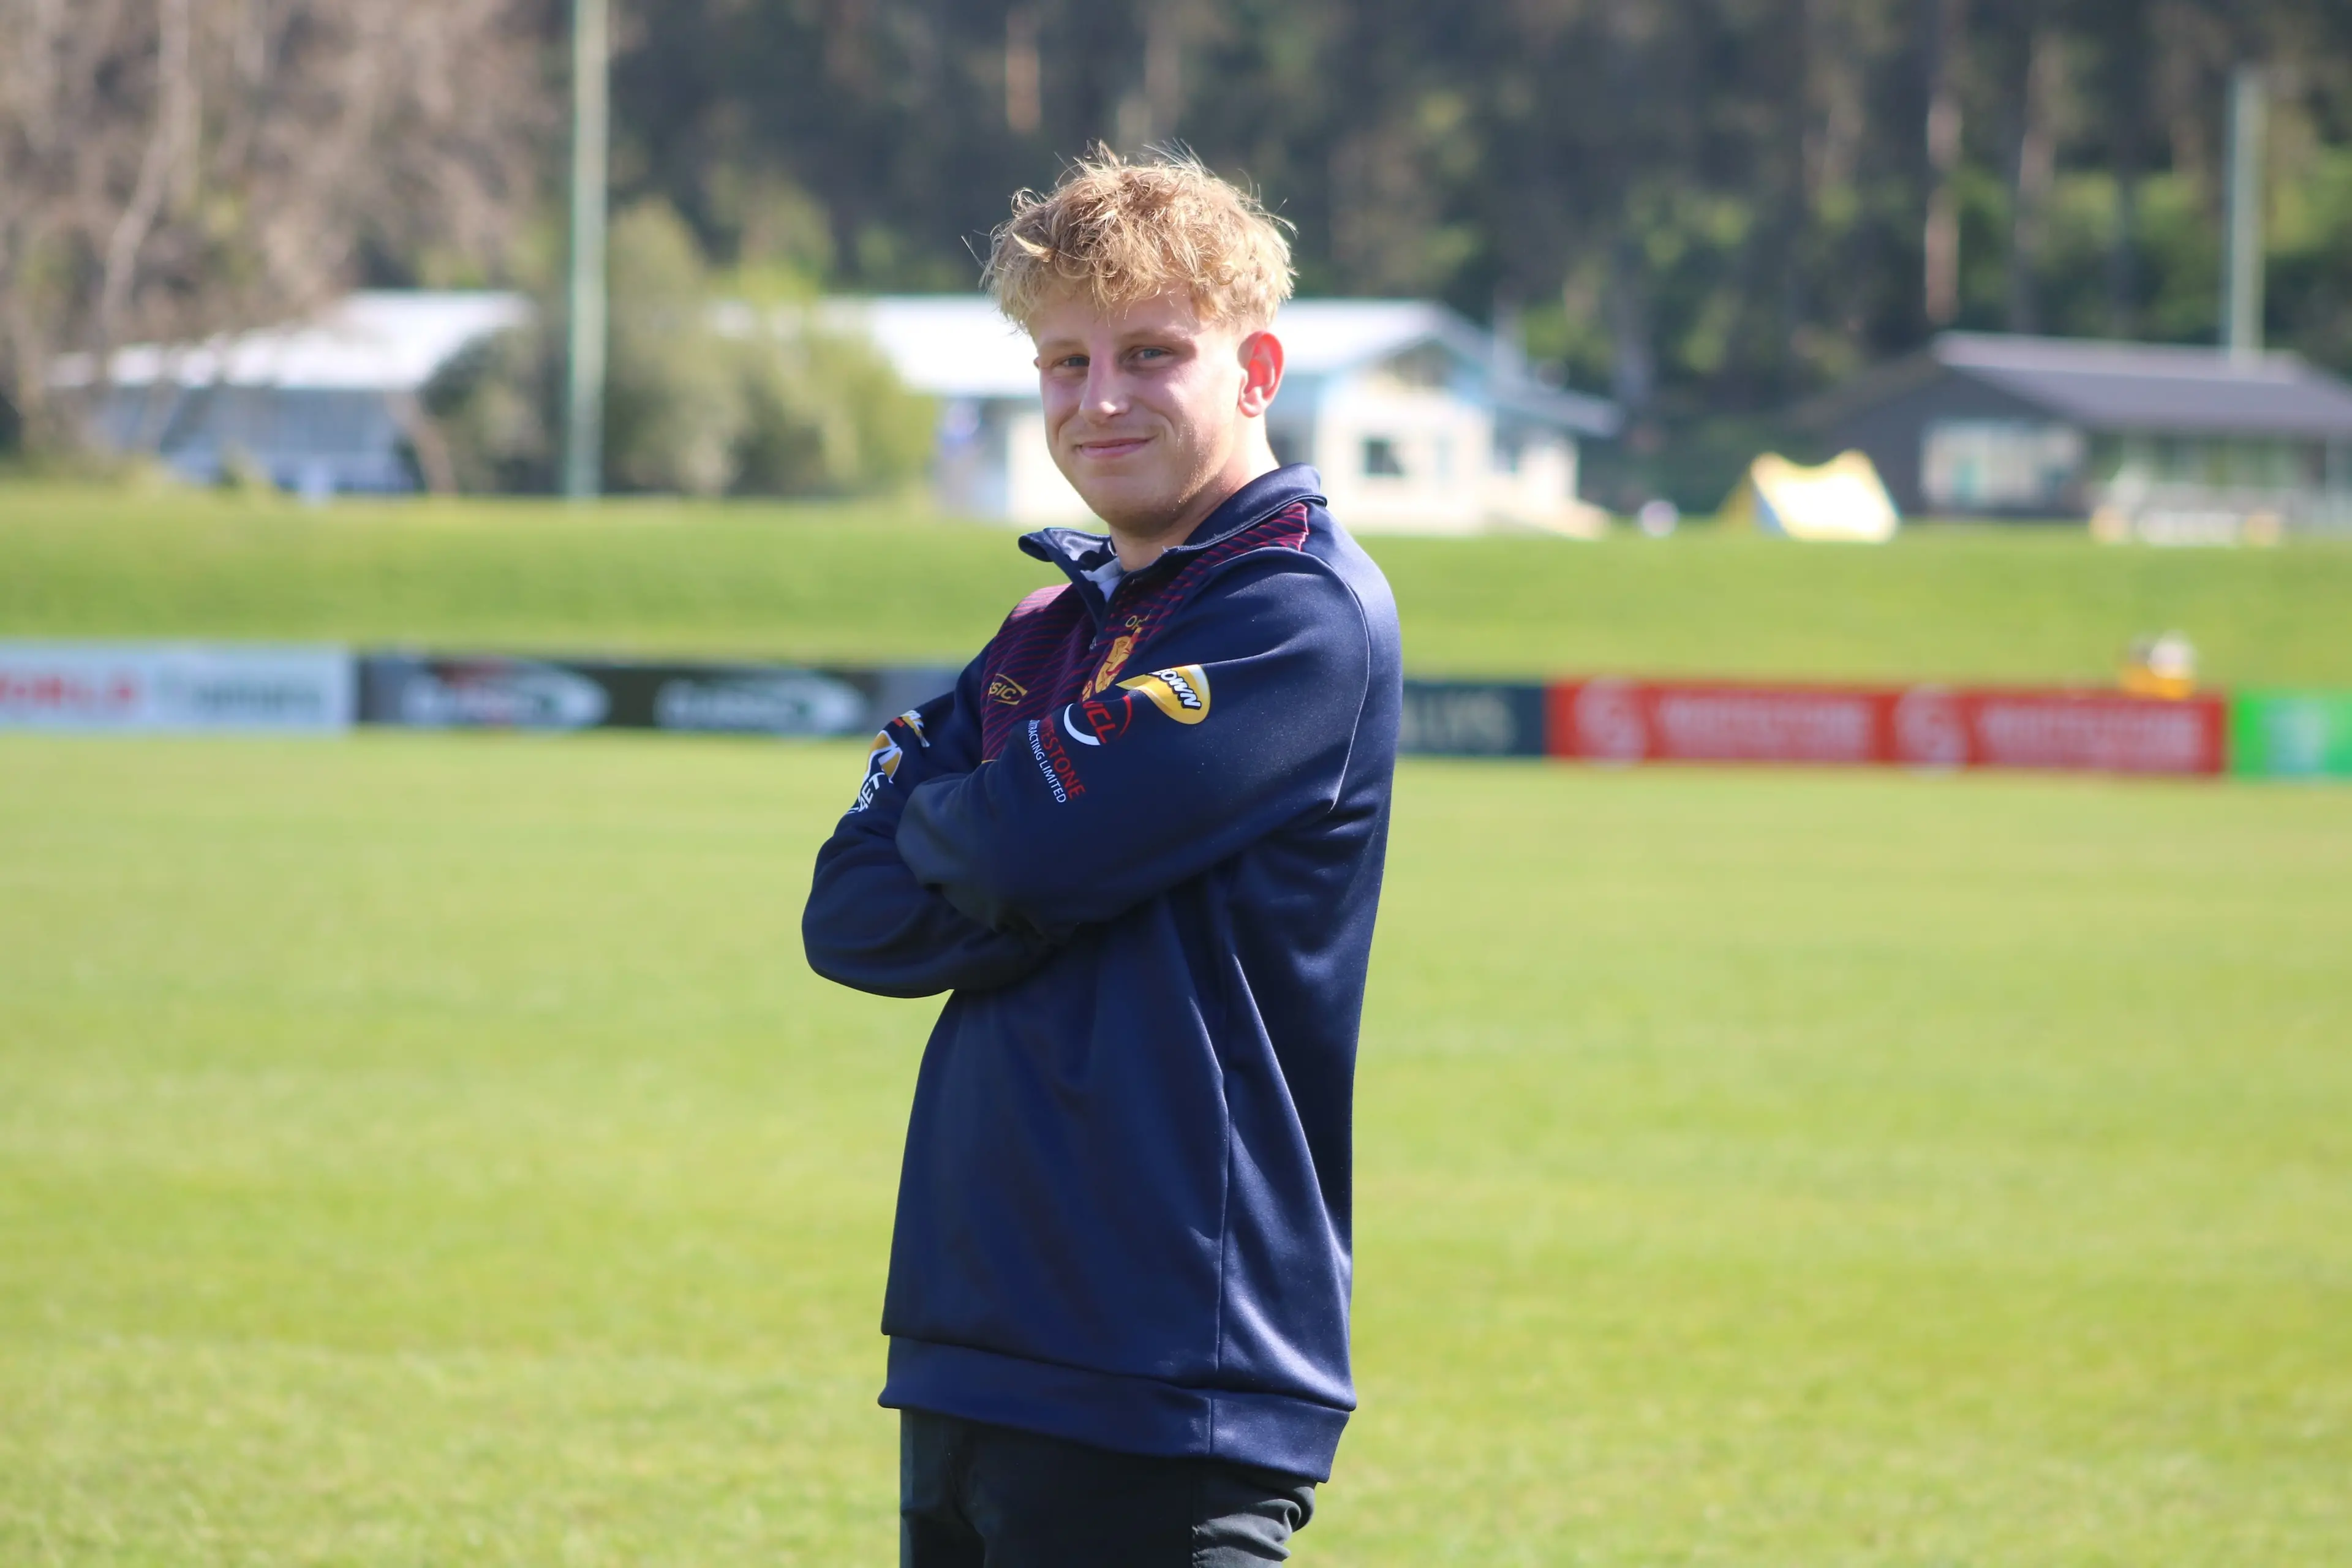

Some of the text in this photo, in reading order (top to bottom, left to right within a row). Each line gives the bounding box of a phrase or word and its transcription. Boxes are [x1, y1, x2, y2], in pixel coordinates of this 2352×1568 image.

[988, 682, 1017, 699] SIC
[1148, 668, 1202, 710] OWN
[1039, 760, 1066, 803] LIMITED
